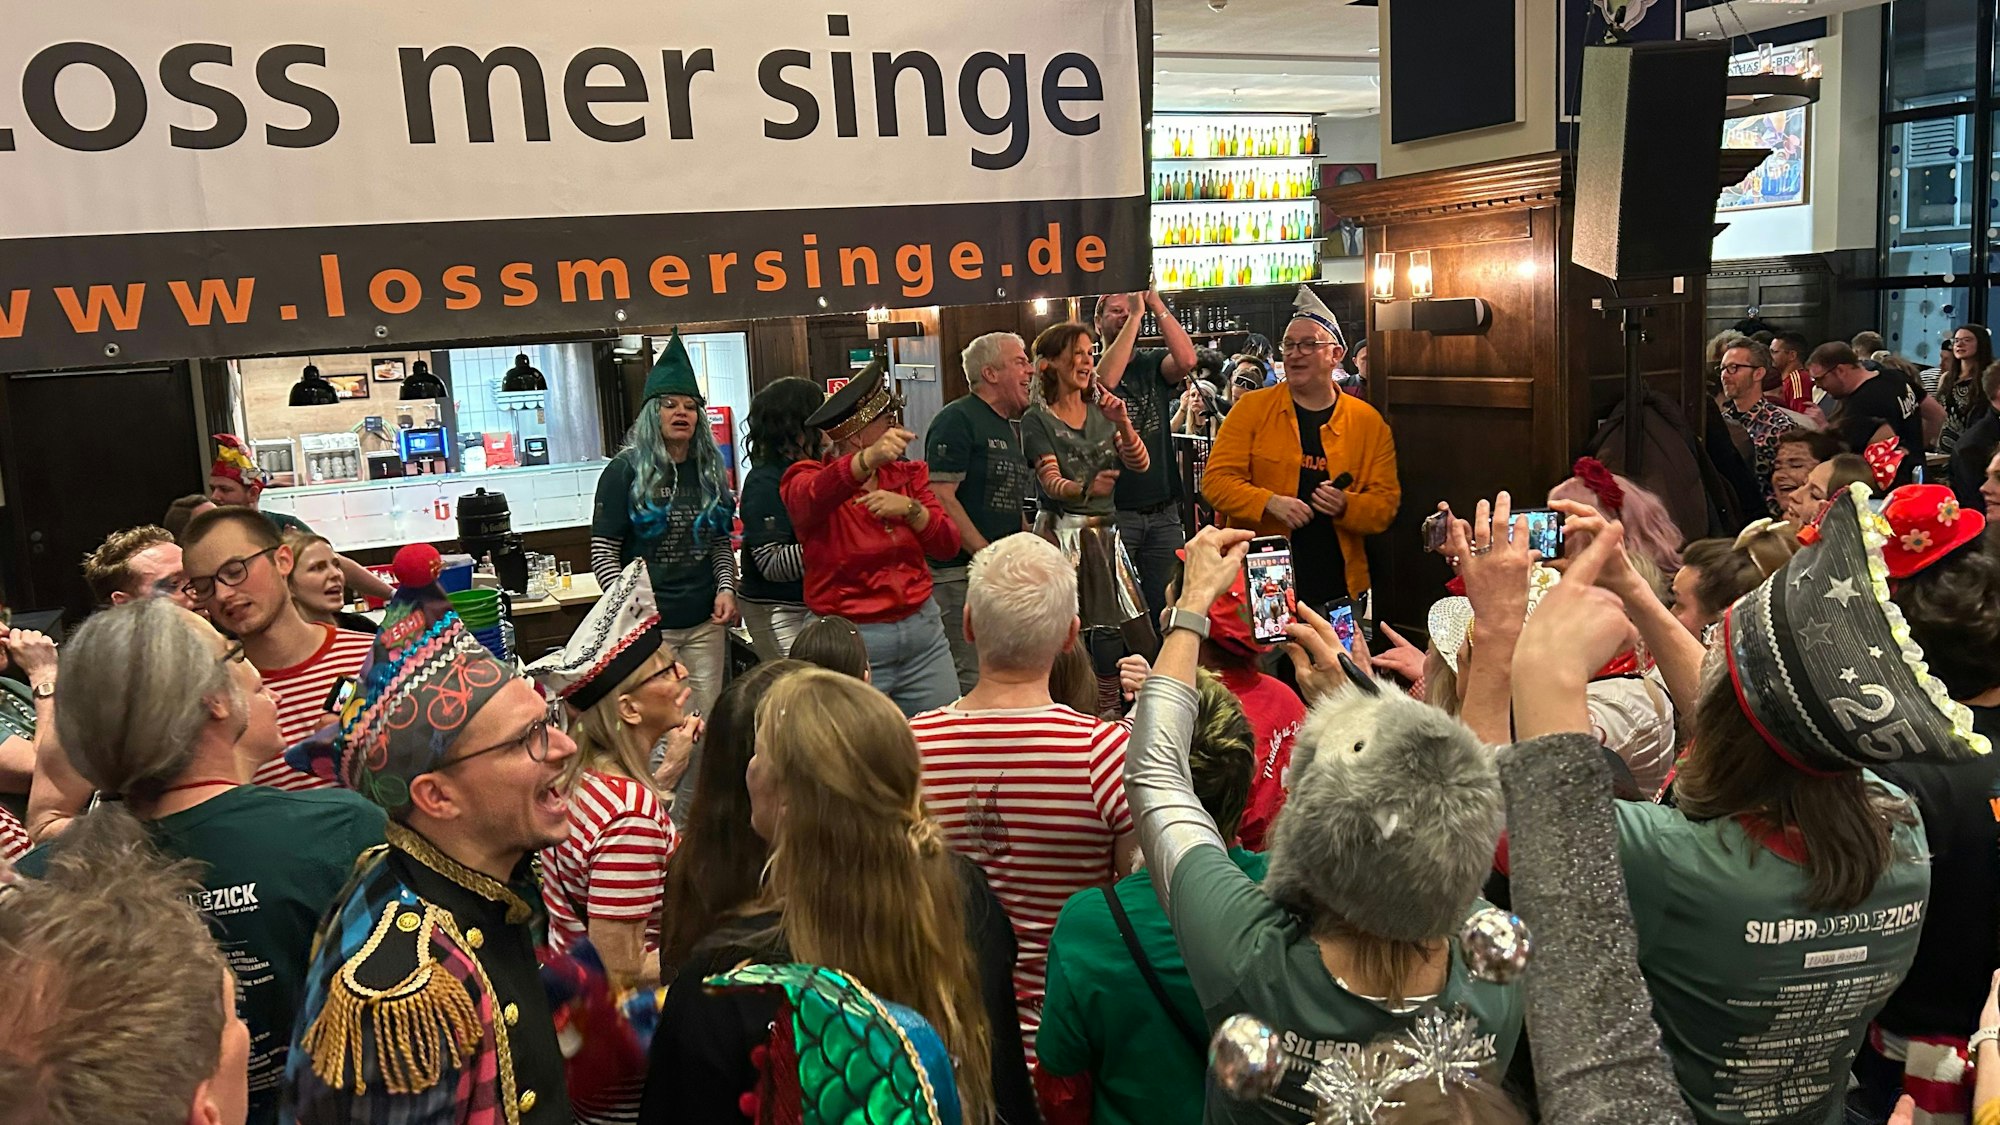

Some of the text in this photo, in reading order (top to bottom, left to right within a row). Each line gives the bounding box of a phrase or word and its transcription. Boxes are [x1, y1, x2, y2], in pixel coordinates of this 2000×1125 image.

[0, 14, 1104, 170] oss mer singe
[1828, 684, 1927, 760] 25
